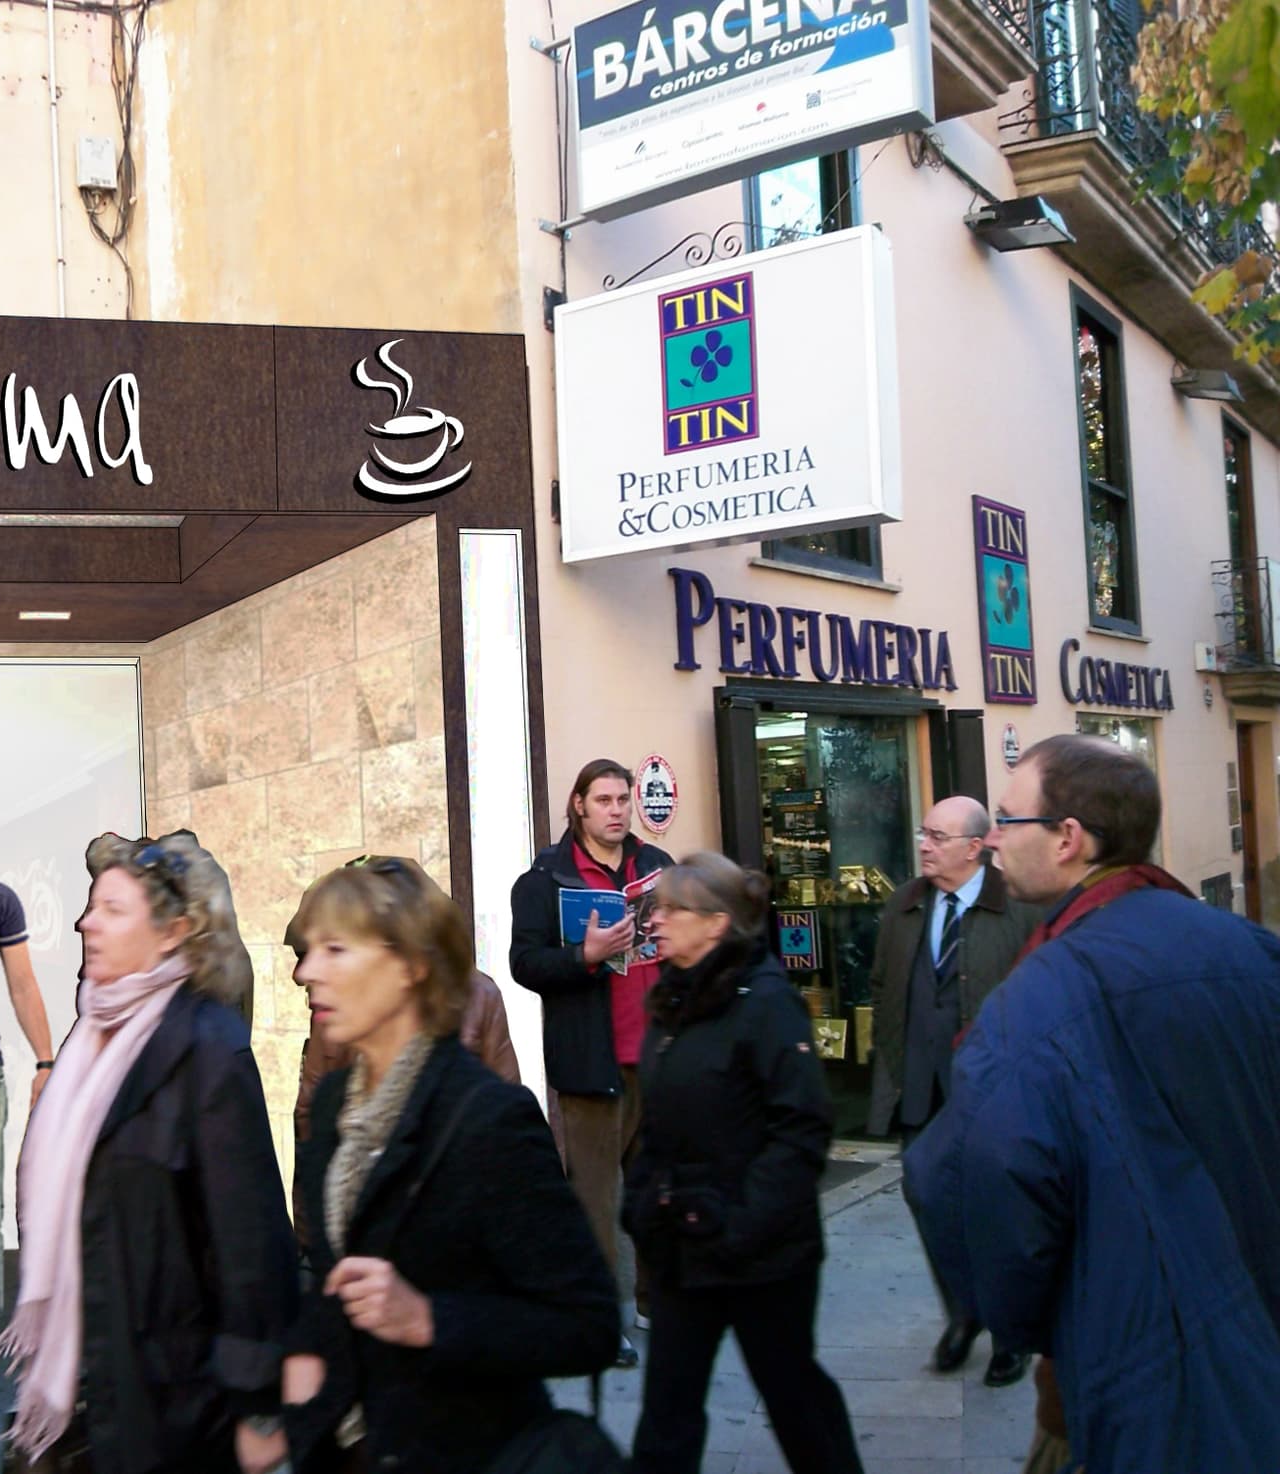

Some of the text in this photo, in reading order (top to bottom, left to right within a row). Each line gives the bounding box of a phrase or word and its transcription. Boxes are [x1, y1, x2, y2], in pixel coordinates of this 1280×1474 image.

[593, 0, 886, 100] BÁRCEN
[650, 10, 888, 99] centros de formación
[665, 281, 745, 331] TIN
[668, 401, 750, 446] TIN
[617, 445, 816, 504] PERFUMERIA
[617, 484, 817, 537] &COSMETICA
[981, 505, 1025, 555] TIN
[668, 568, 958, 692] PERFUMERIA
[989, 653, 1034, 698] TIN
[1060, 637, 1174, 711] COSMETICA
[781, 913, 810, 927] TIN
[783, 955, 812, 969] TIN
